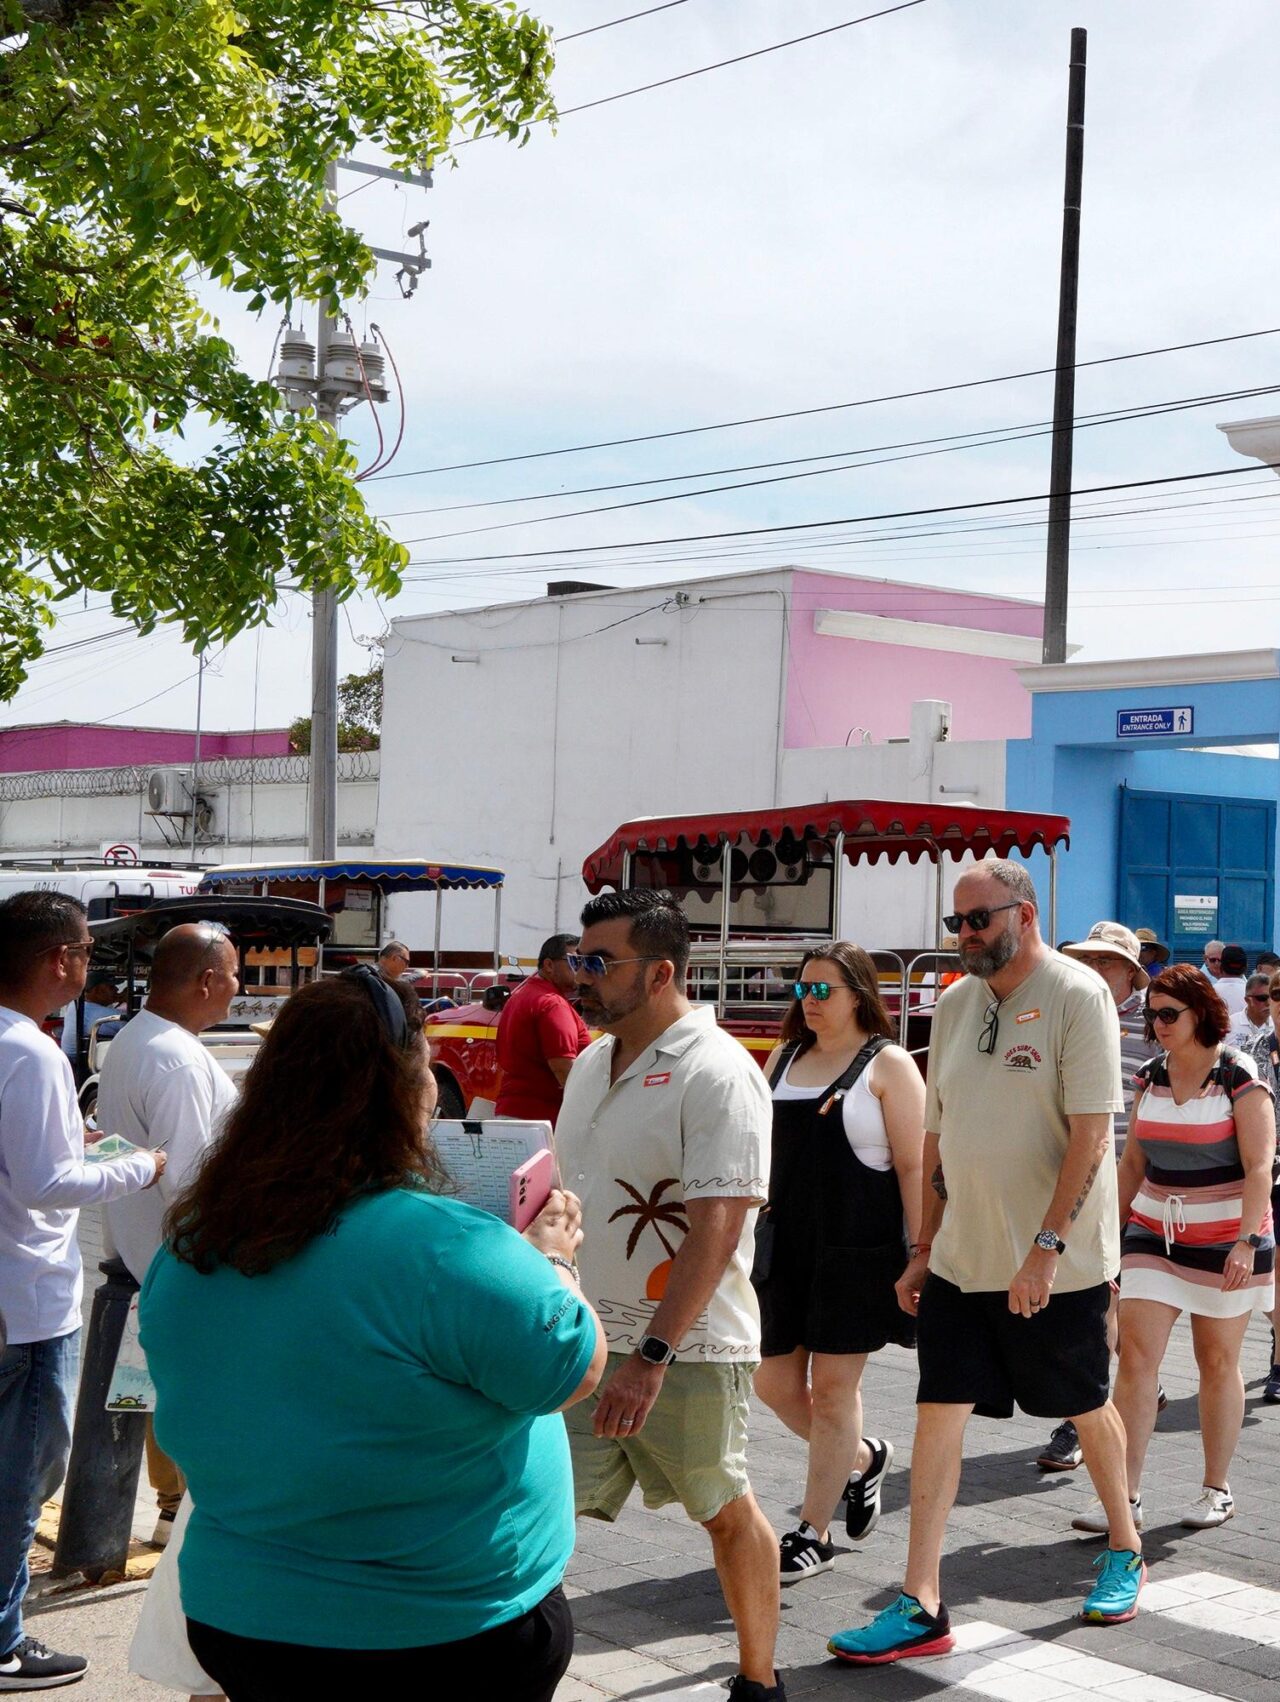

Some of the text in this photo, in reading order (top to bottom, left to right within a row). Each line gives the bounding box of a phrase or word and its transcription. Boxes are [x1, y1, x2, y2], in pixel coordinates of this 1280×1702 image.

[1130, 714, 1163, 724] ENTRADA
[1122, 722, 1171, 731] ENTRANCE ONLY
